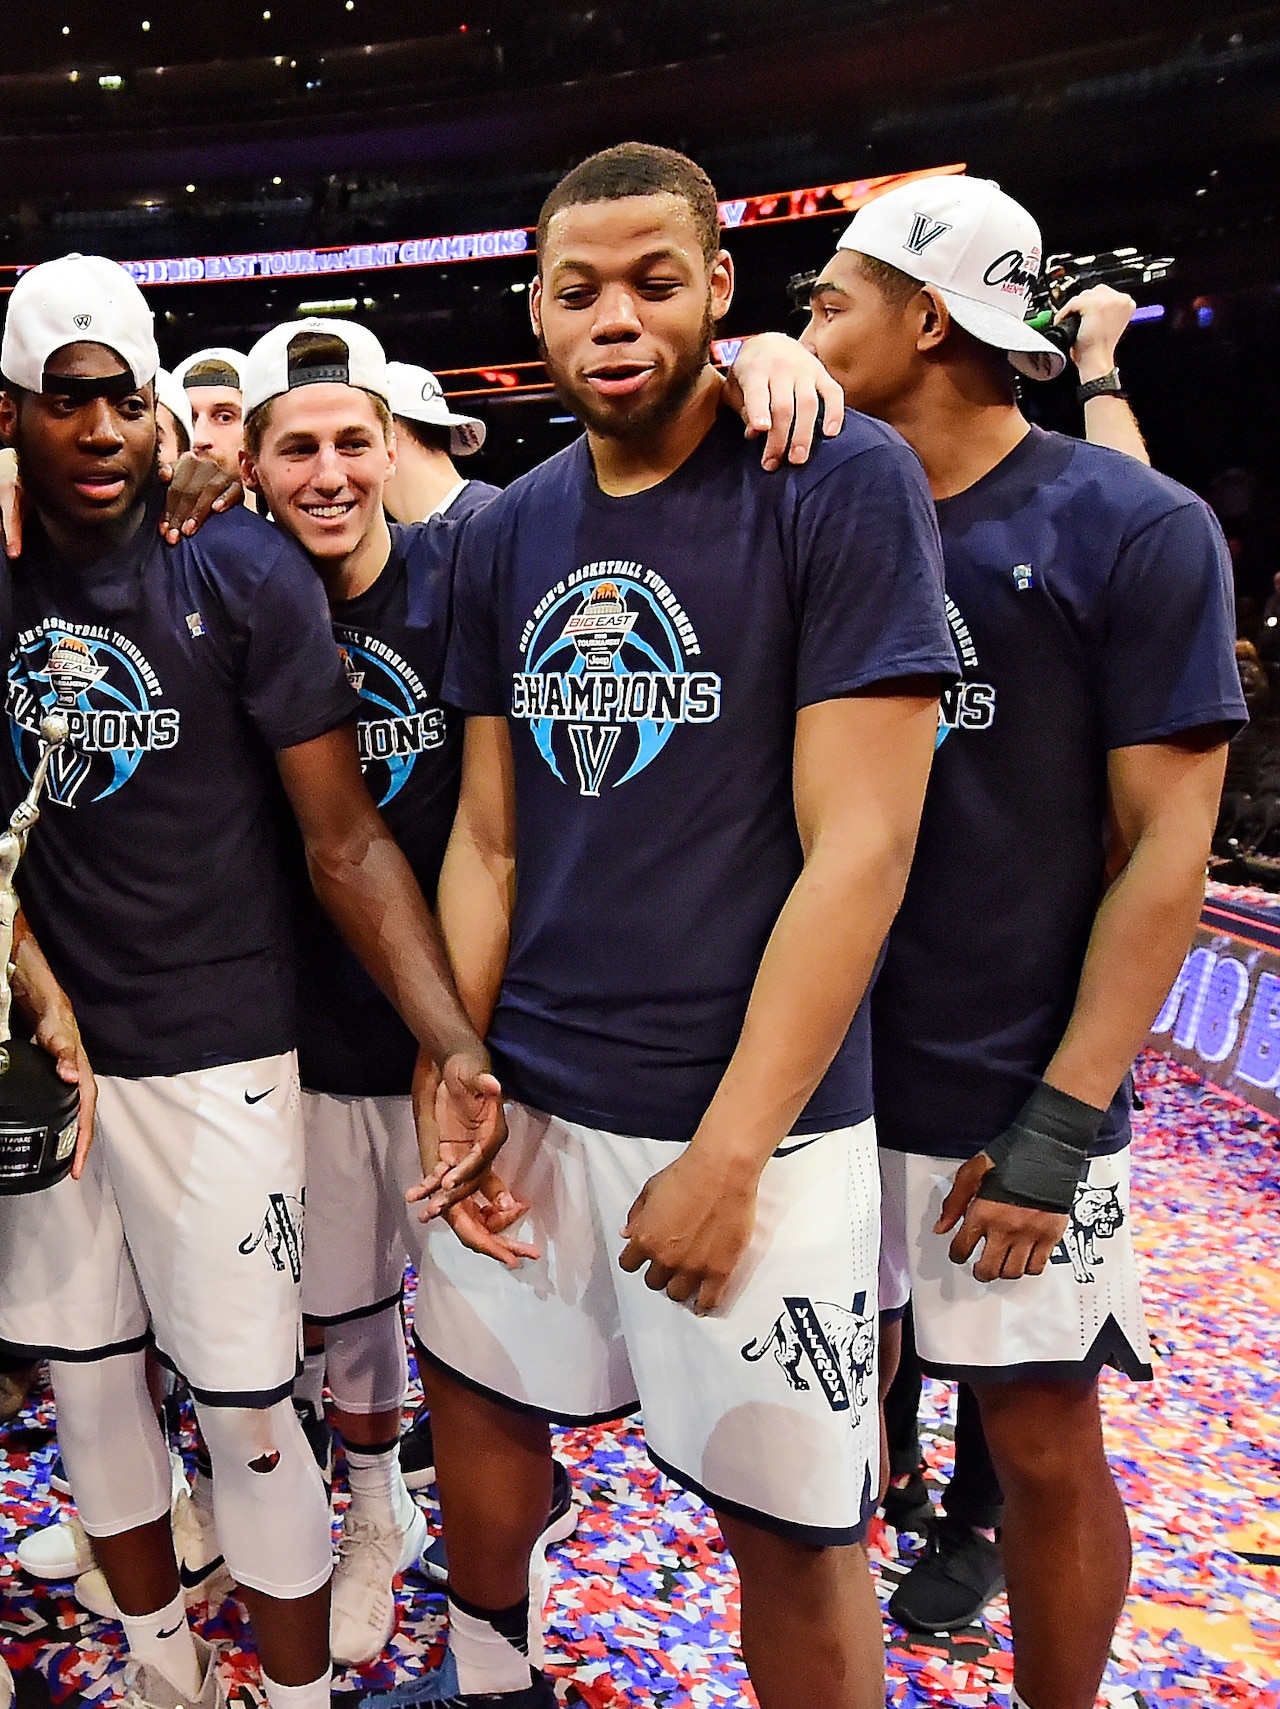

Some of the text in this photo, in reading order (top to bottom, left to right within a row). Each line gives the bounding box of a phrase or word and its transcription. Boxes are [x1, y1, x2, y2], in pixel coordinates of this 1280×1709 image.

[204, 256, 255, 279] EAST
[256, 244, 399, 276] TOURNAMENT
[399, 230, 527, 264] CHAMPIONS
[903, 212, 952, 255] V
[568, 560, 643, 587] BASKETBALL
[642, 569, 702, 657] TOURNAMENT
[569, 615, 632, 627] BIG EAST
[64, 662, 104, 676] EAST
[112, 631, 163, 697] TOURNAMENT
[363, 635, 428, 700] TOURNAMENT
[511, 671, 721, 723] CHAMPIONS
[568, 724, 621, 797] V
[795, 1307, 845, 1403] VILLANOVA
